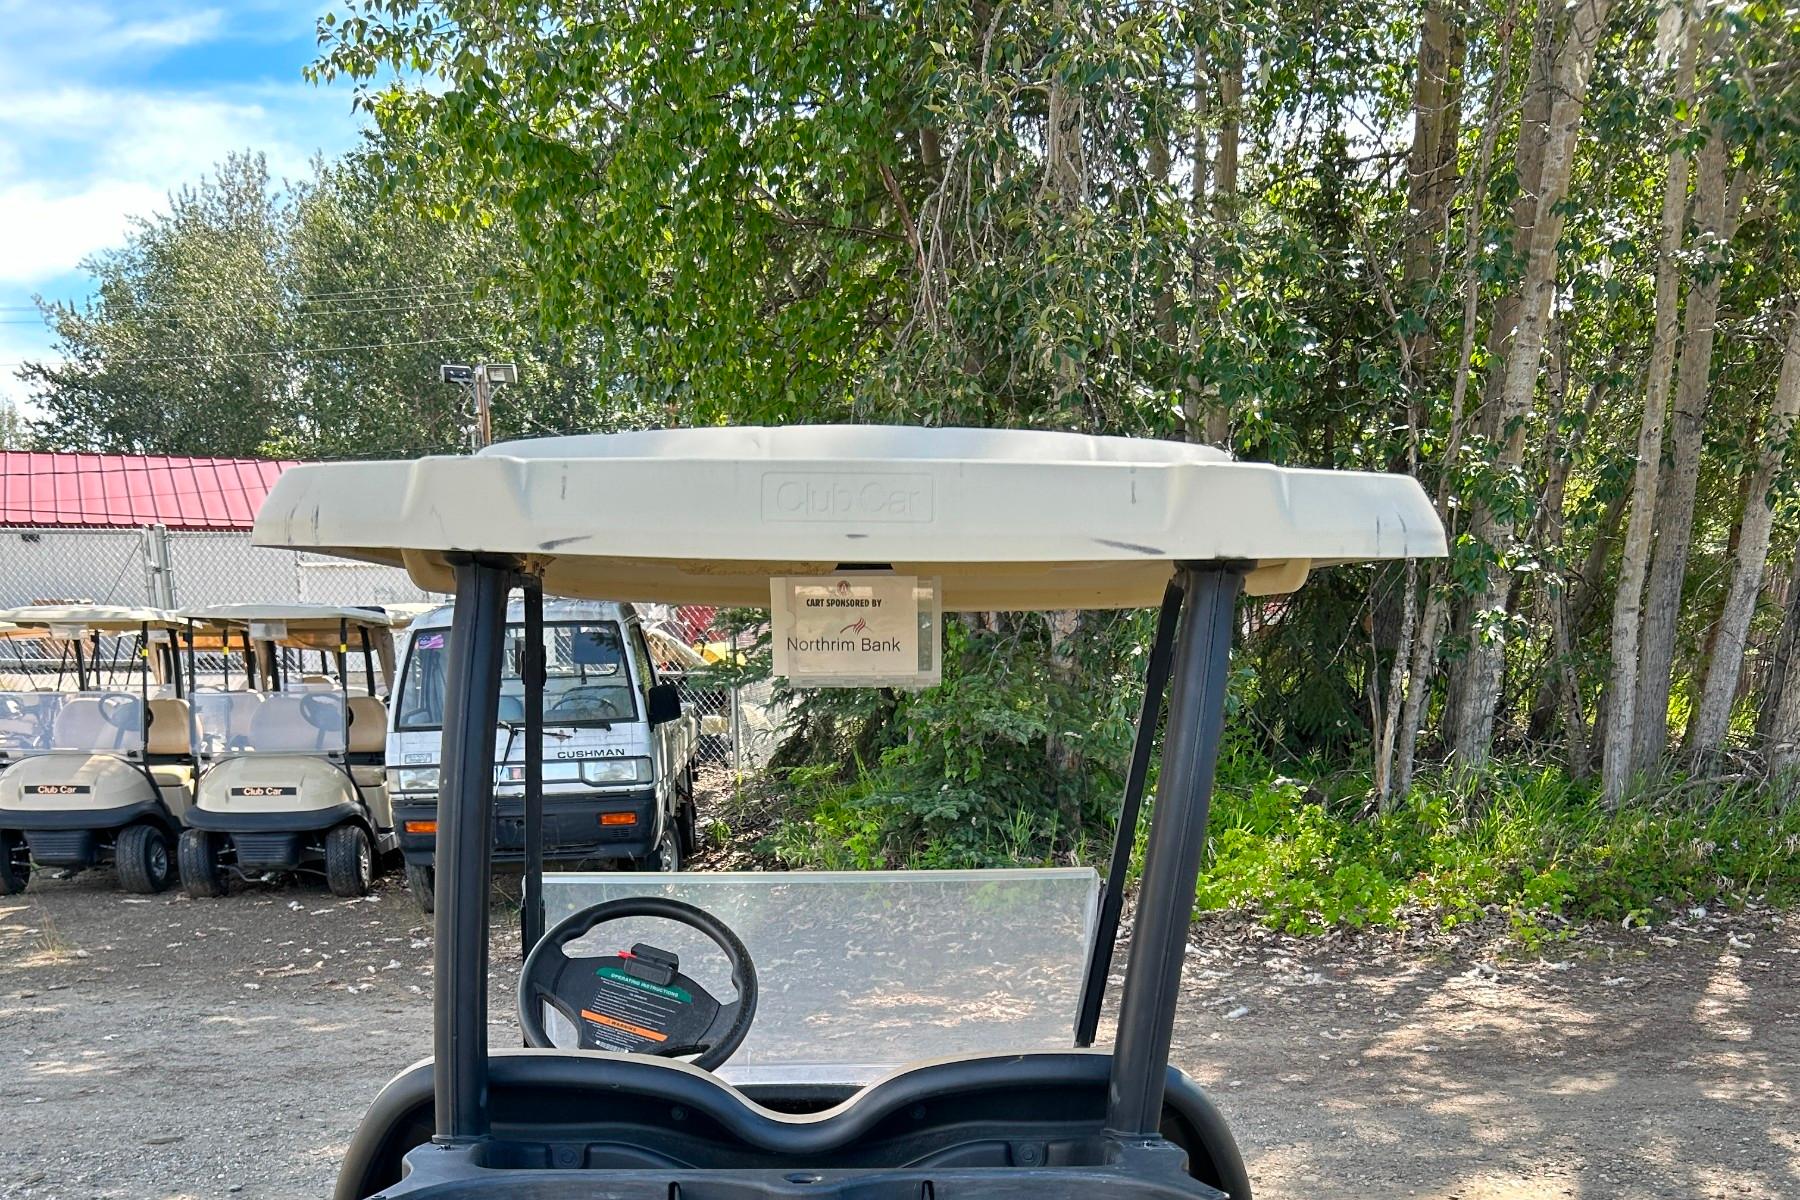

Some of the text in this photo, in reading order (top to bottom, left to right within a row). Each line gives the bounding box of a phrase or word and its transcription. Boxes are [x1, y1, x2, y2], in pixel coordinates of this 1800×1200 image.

[777, 481, 920, 516] Club Car
[806, 598, 882, 608] CART SPONSORED BY
[787, 637, 901, 652] Northrim Bank
[557, 748, 625, 759] CUSHMAN
[38, 786, 76, 794] Club Car
[243, 787, 282, 796] Club Car
